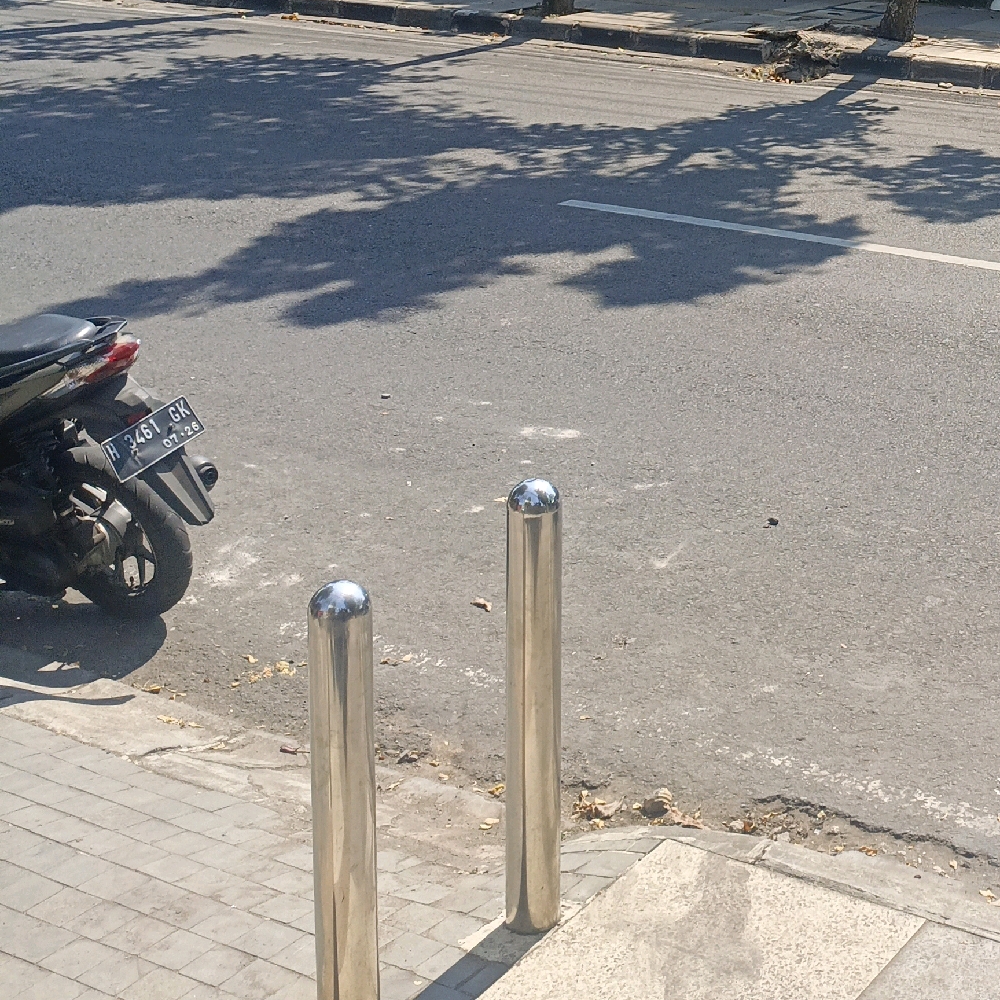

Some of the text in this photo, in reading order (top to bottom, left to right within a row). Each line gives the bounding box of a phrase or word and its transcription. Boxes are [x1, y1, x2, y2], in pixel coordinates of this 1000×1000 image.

[106, 399, 190, 461] H 3461 GK
